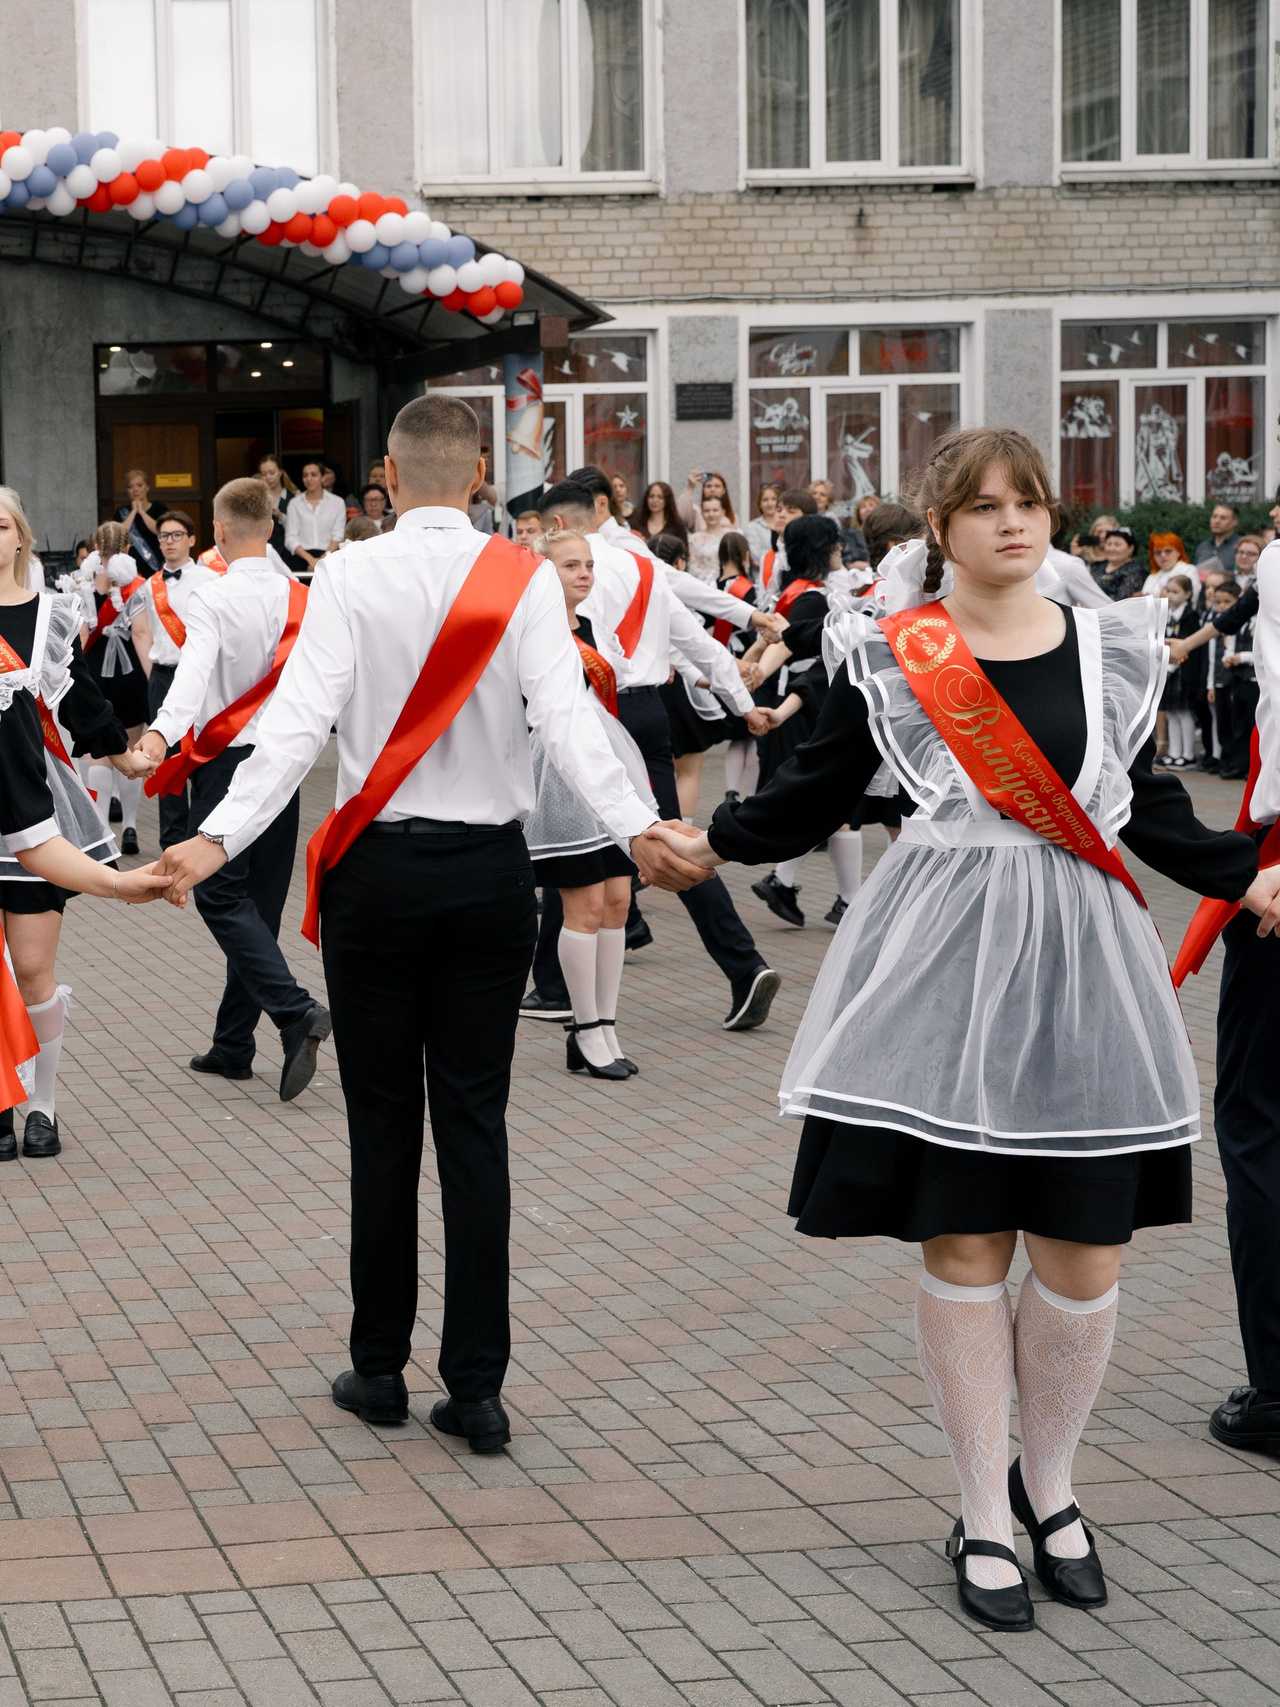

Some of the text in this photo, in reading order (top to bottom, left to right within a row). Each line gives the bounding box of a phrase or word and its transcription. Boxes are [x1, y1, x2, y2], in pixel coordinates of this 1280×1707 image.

[917, 630, 929, 641] 11
[930, 707, 957, 741] МАОУ
[950, 735, 973, 763] СОШ
[1011, 736, 1095, 849] Качурка Вероника
